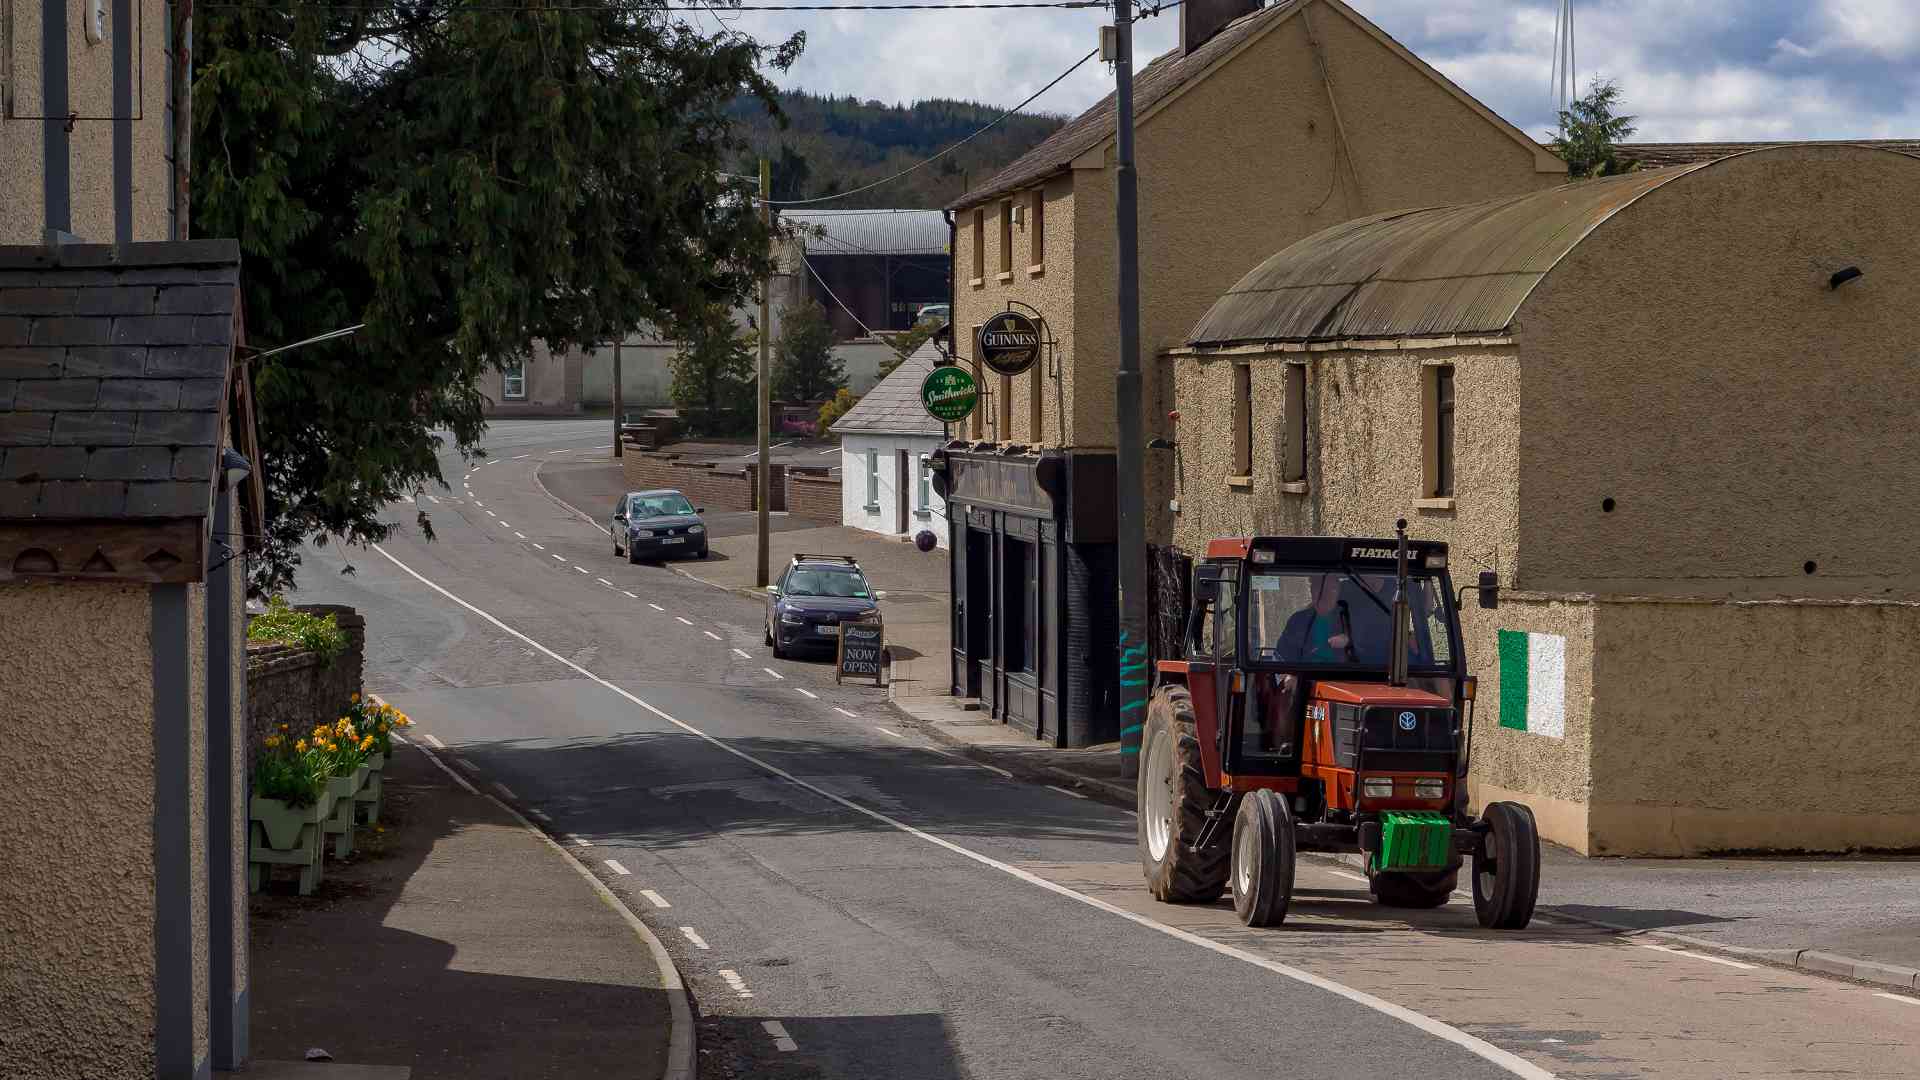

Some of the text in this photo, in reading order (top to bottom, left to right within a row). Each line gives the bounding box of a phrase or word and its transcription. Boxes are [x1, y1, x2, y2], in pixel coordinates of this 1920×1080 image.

[983, 333, 1037, 346] GUINNESS
[927, 384, 977, 407] Smithwick's
[847, 648, 876, 661] NOW
[842, 662, 878, 673] OPEN
